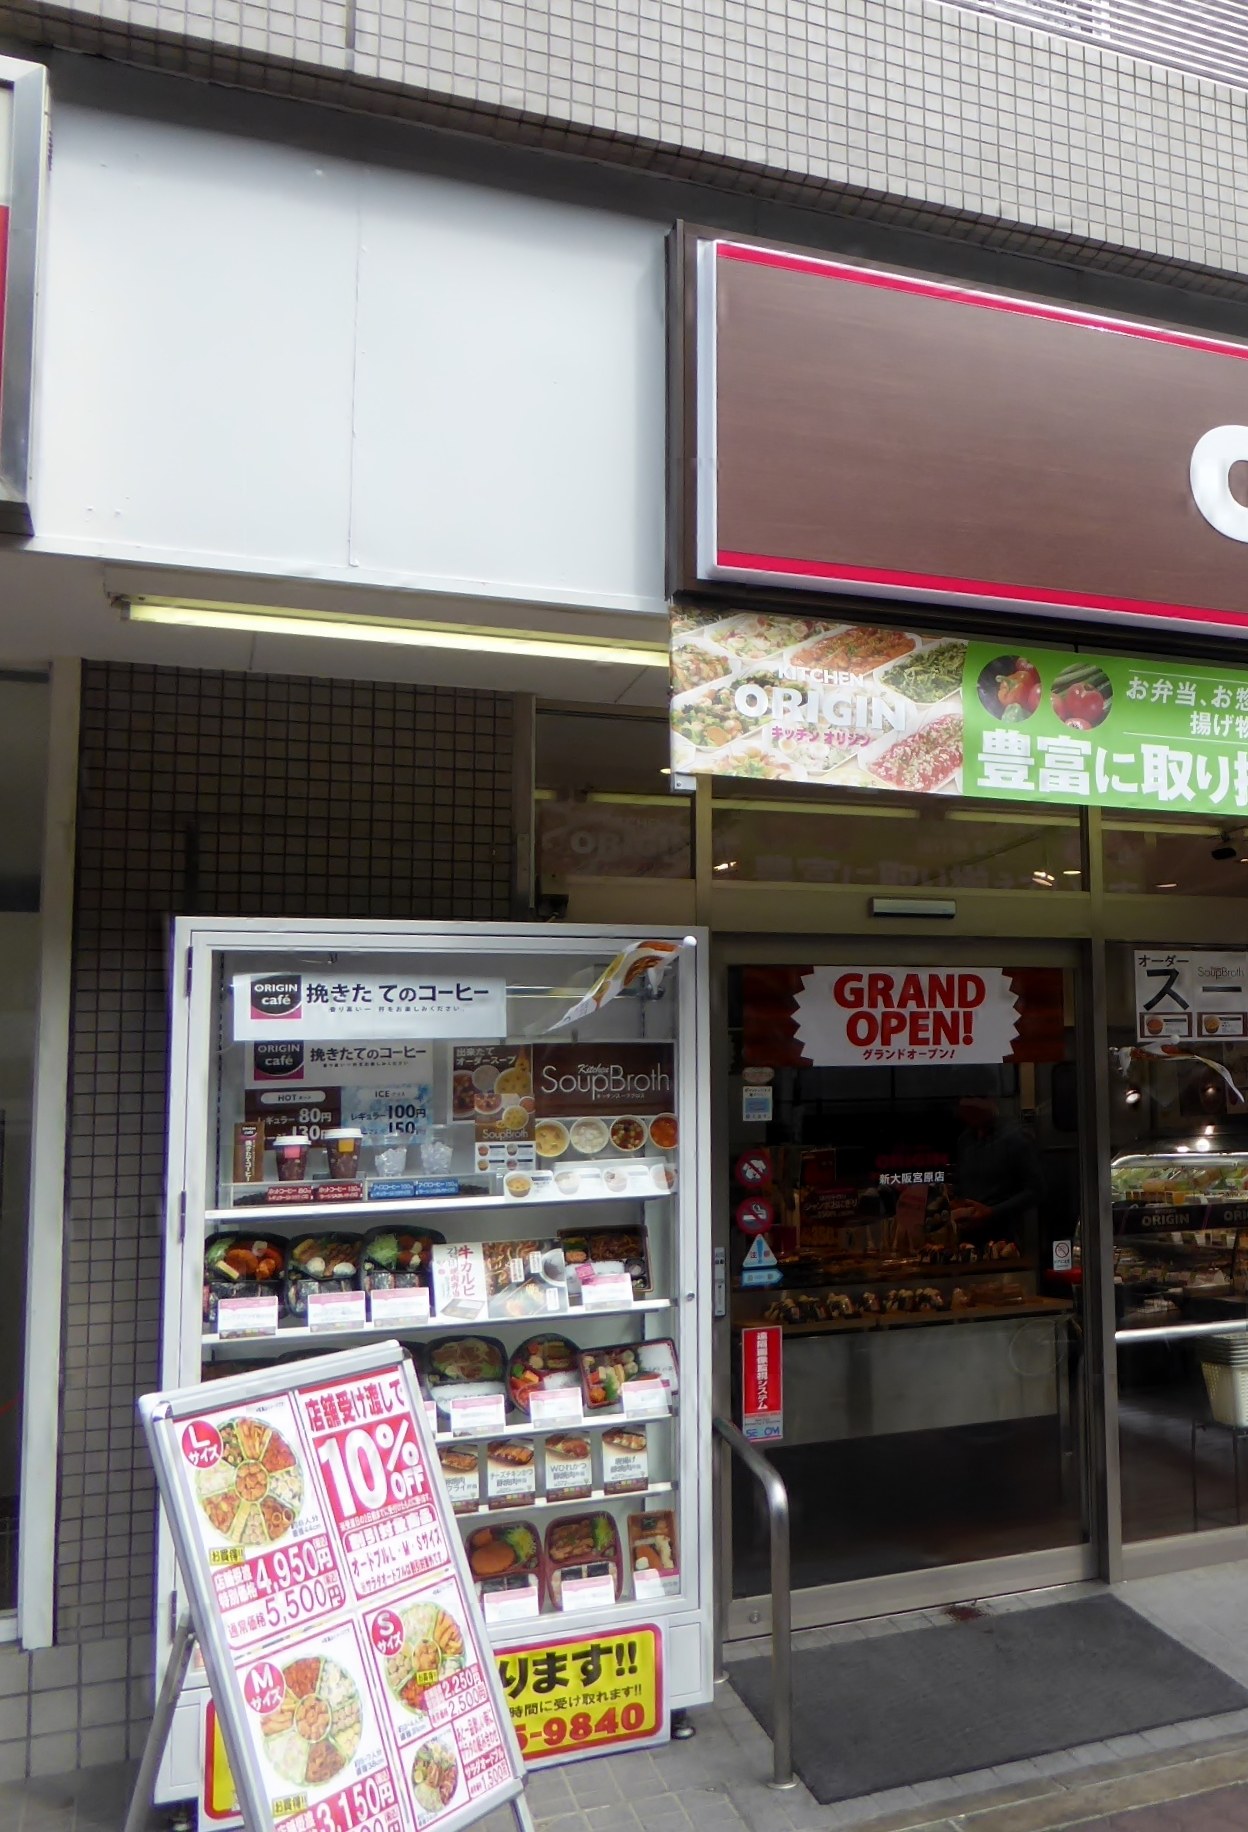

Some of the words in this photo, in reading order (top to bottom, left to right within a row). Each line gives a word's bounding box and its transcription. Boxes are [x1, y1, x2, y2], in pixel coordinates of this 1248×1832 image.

[778, 666, 864, 688] KITCHEN
[734, 684, 906, 731] ORIGIN
[771, 726, 819, 742] キッチン
[823, 731, 871, 747] オリジン
[1138, 954, 1189, 967] オーダー
[254, 983, 298, 992] ORIGIN
[833, 973, 986, 1010] GRAND
[261, 994, 291, 1006] café
[846, 1011, 975, 1047] OPEN!
[257, 1044, 300, 1053] ORIGIN
[310, 1046, 426, 1062] 挽きたてのコーヒー
[862, 1047, 956, 1062] グランドオープン!
[264, 1055, 294, 1067] café
[577, 1063, 609, 1074] Kitchen
[540, 1063, 670, 1100] SoupBroth
[278, 1094, 296, 1102] HOT
[375, 1090, 390, 1098] ICE
[298, 1107, 332, 1123] 80円
[387, 1105, 427, 1120] 100円
[482, 1128, 529, 1140] SoupBroth
[879, 1171, 945, 1186] 新大阪宮原店
[1141, 1213, 1190, 1227] ORIGIN
[458, 1244, 476, 1297] 牛カルビ
[188, 1424, 211, 1449] L
[188, 1446, 220, 1466] サイズ
[318, 1418, 420, 1518] 10%
[390, 1467, 425, 1500] OFF
[266, 1579, 344, 1627] 5,500円
[377, 1613, 395, 1636] S
[377, 1633, 403, 1654] サイズ
[252, 1664, 275, 1694] M
[251, 1689, 282, 1711] サイズ
